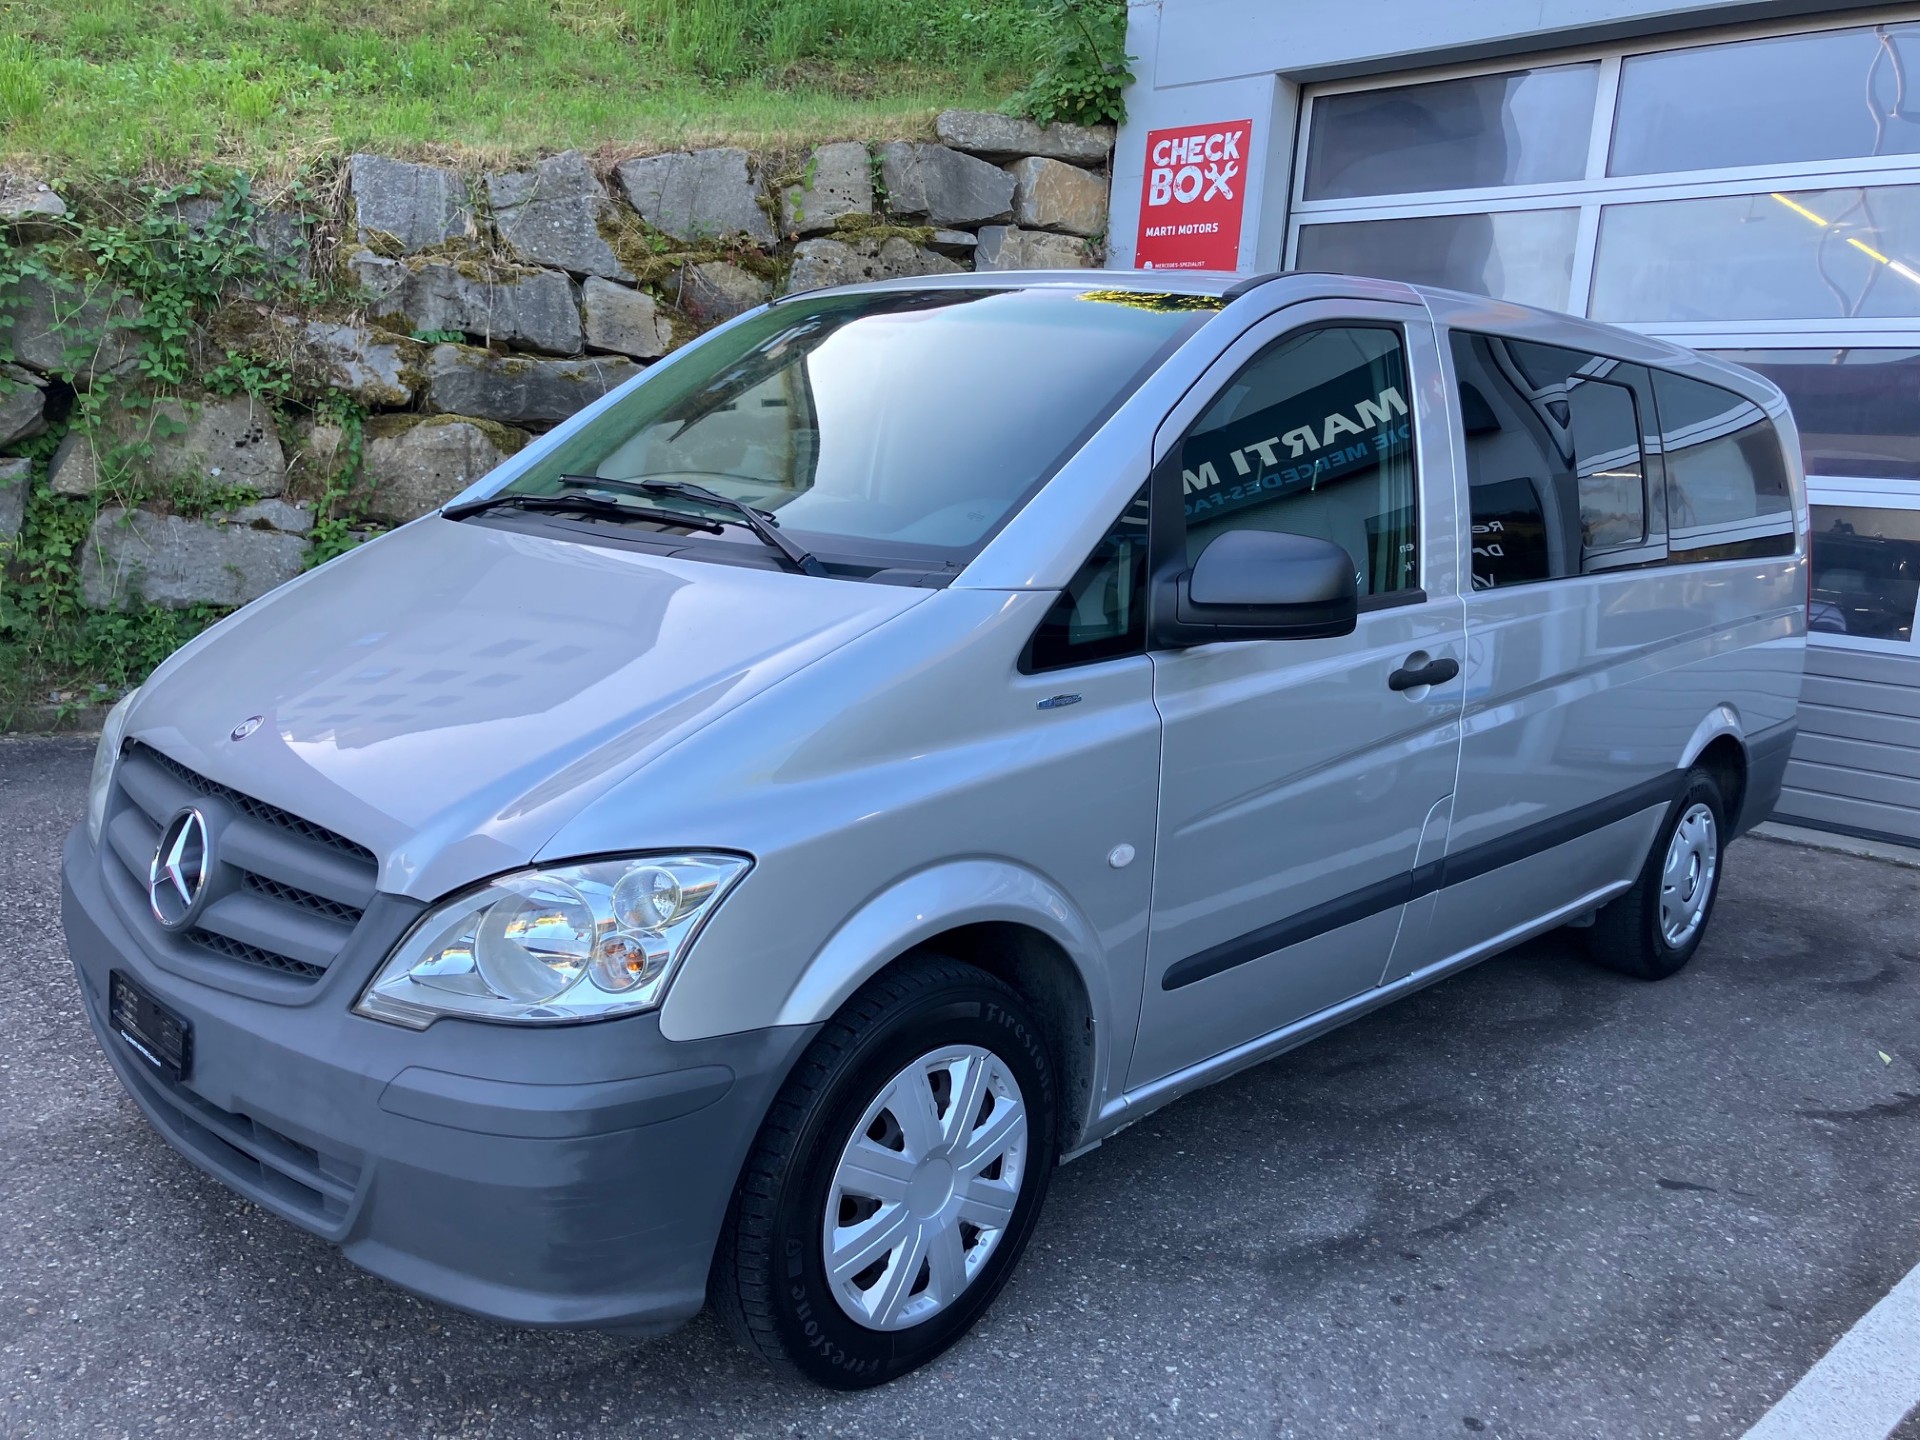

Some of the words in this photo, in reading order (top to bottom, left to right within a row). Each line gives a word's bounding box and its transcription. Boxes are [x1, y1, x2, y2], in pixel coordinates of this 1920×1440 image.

[1152, 131, 1243, 167] CHECK
[1148, 160, 1239, 206] BOX
[1145, 224, 1176, 237] MARTI
[1178, 222, 1219, 235] MOTORS
[985, 1002, 1052, 1105] Firestone
[791, 1280, 880, 1377] Firestone
